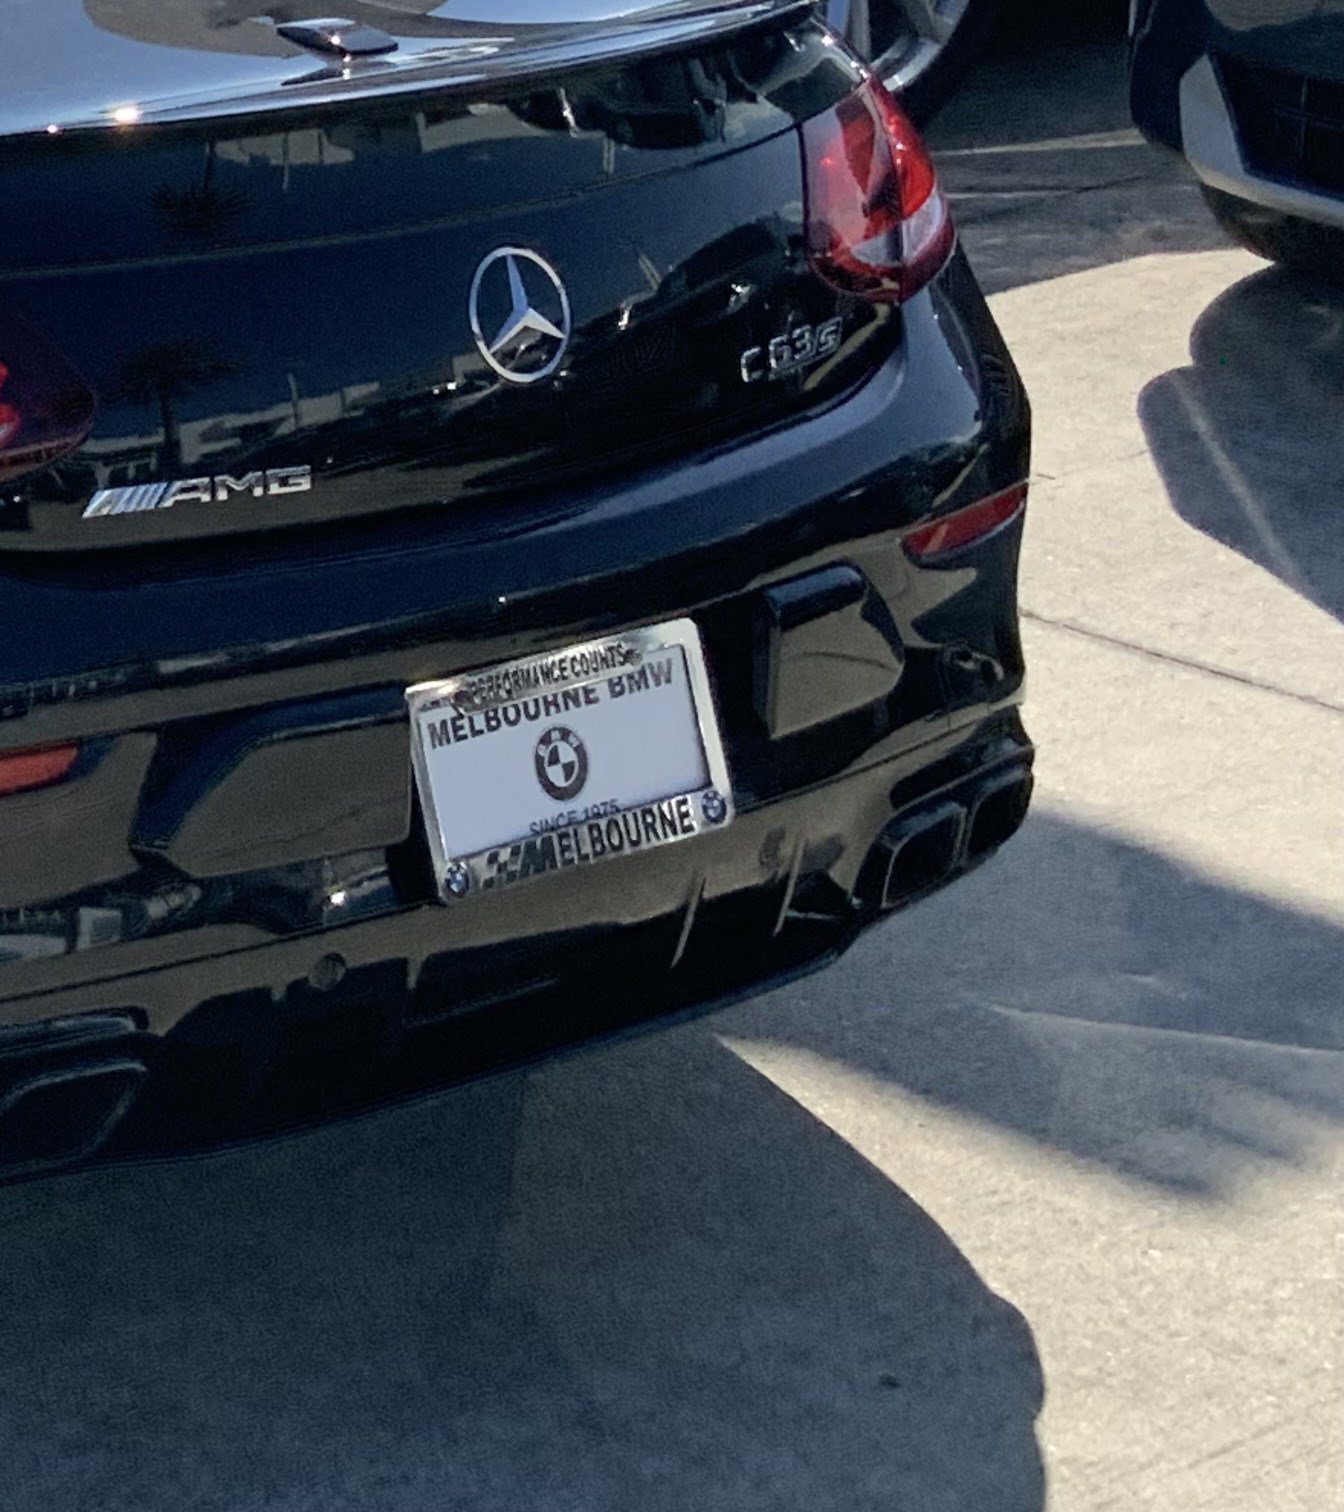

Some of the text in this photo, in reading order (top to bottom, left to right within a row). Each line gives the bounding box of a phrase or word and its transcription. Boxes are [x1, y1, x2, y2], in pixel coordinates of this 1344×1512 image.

[158, 464, 312, 509] AMG
[426, 656, 674, 750] MELBOURNE BMW
[470, 641, 627, 700] PERFORMANCE COUNTS
[519, 795, 696, 878] MELBOURNE
